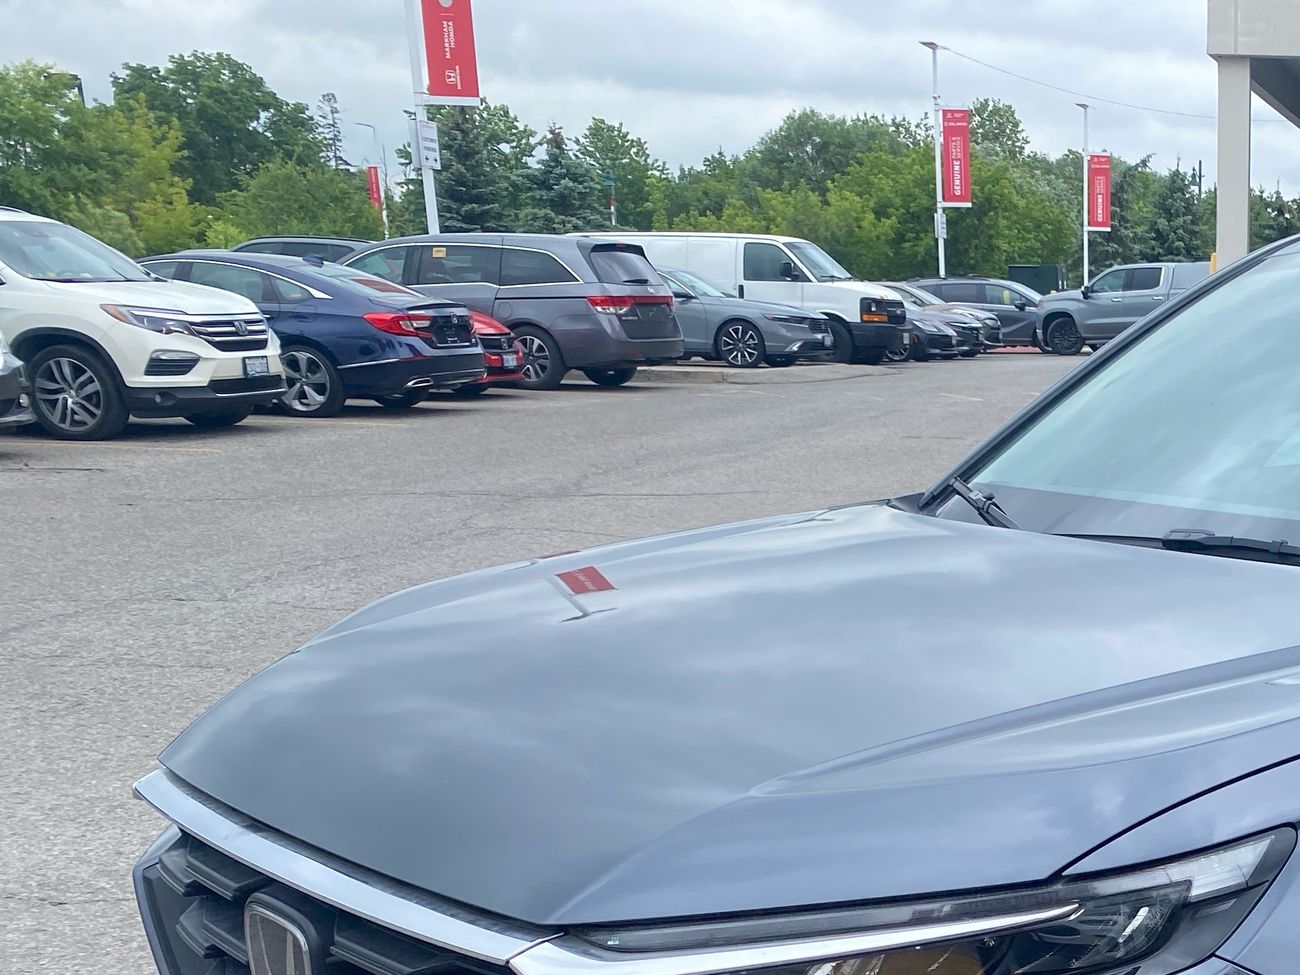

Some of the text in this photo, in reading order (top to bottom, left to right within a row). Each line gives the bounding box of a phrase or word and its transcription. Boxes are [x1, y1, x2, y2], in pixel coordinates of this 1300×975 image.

[441, 20, 451, 59] MARKHAM
[447, 20, 456, 48] HONDA
[953, 160, 961, 196] GENUINE
